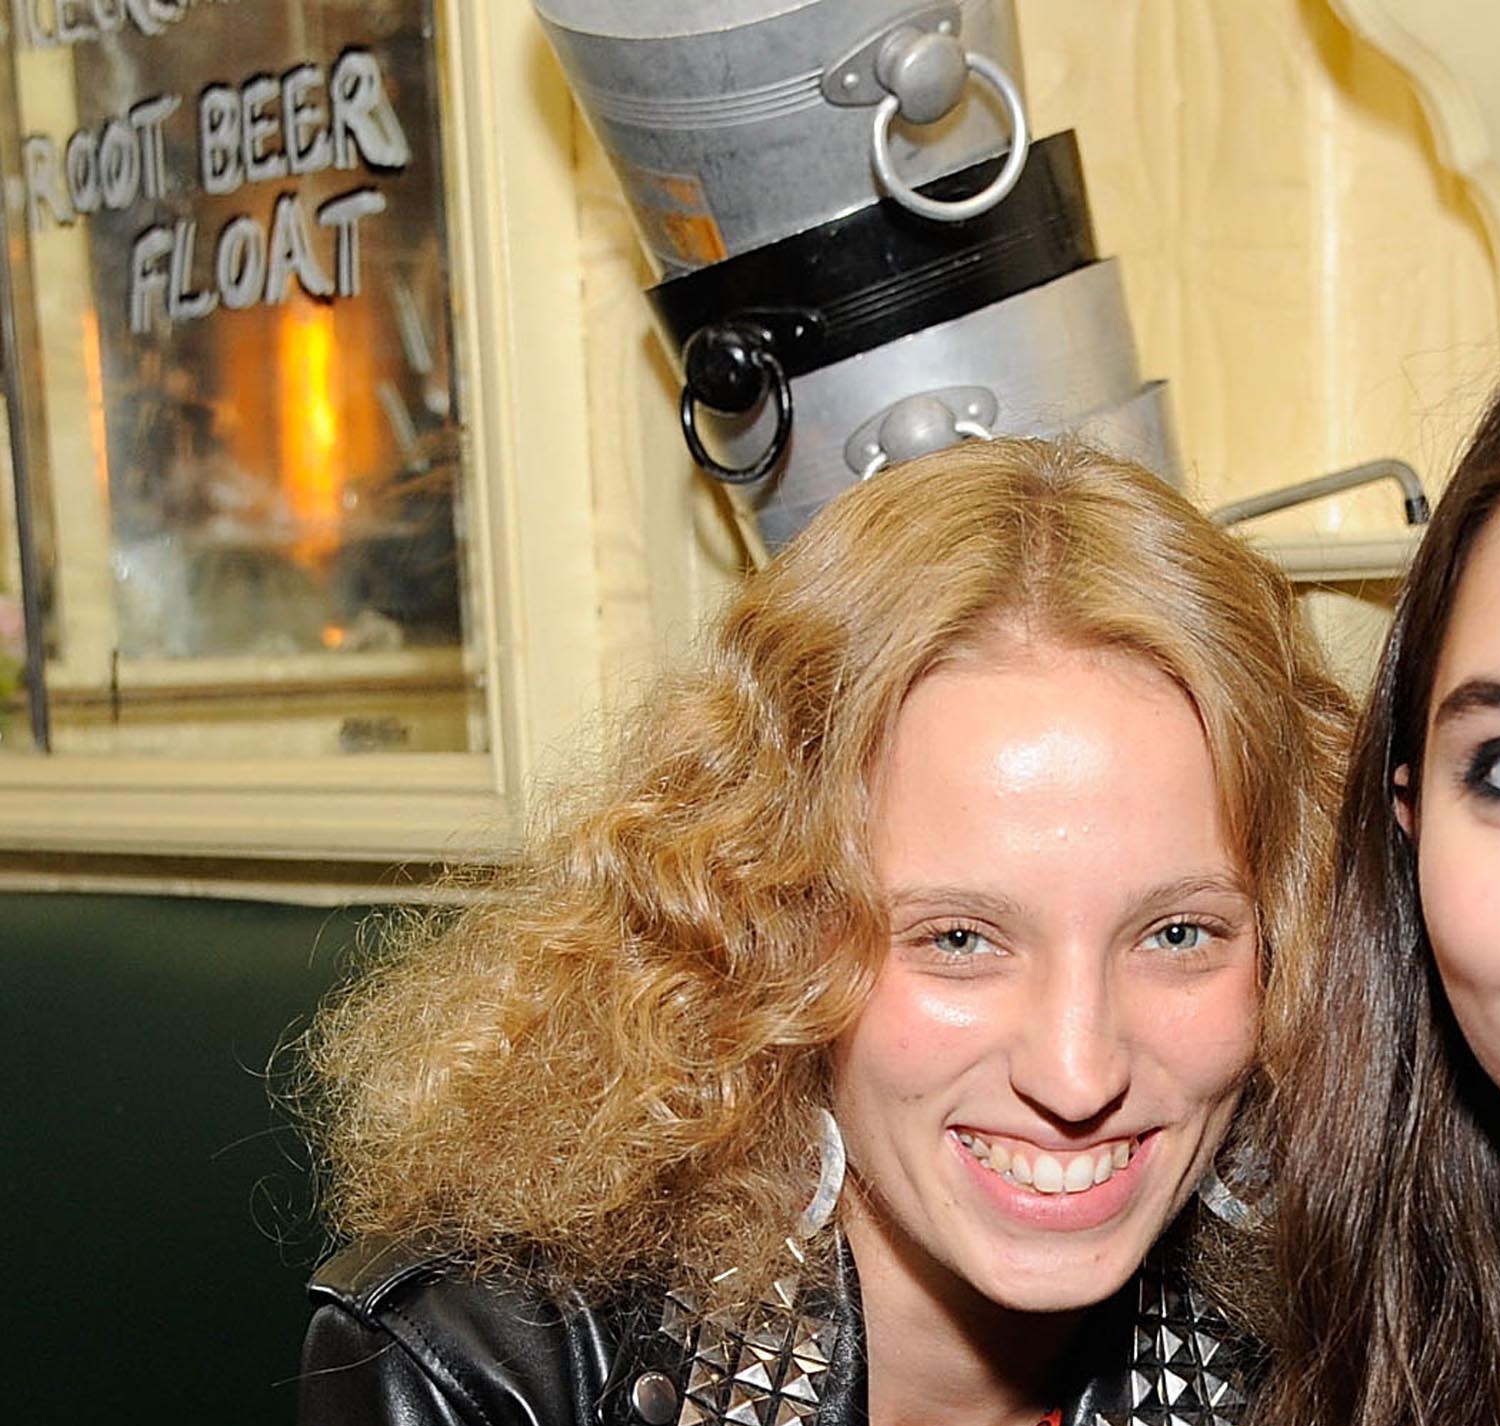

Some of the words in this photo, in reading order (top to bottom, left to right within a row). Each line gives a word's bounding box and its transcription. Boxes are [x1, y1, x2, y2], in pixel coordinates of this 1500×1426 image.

[22, 94, 183, 227] ROOT
[198, 46, 413, 196] BEER
[130, 187, 387, 333] FLOAT
